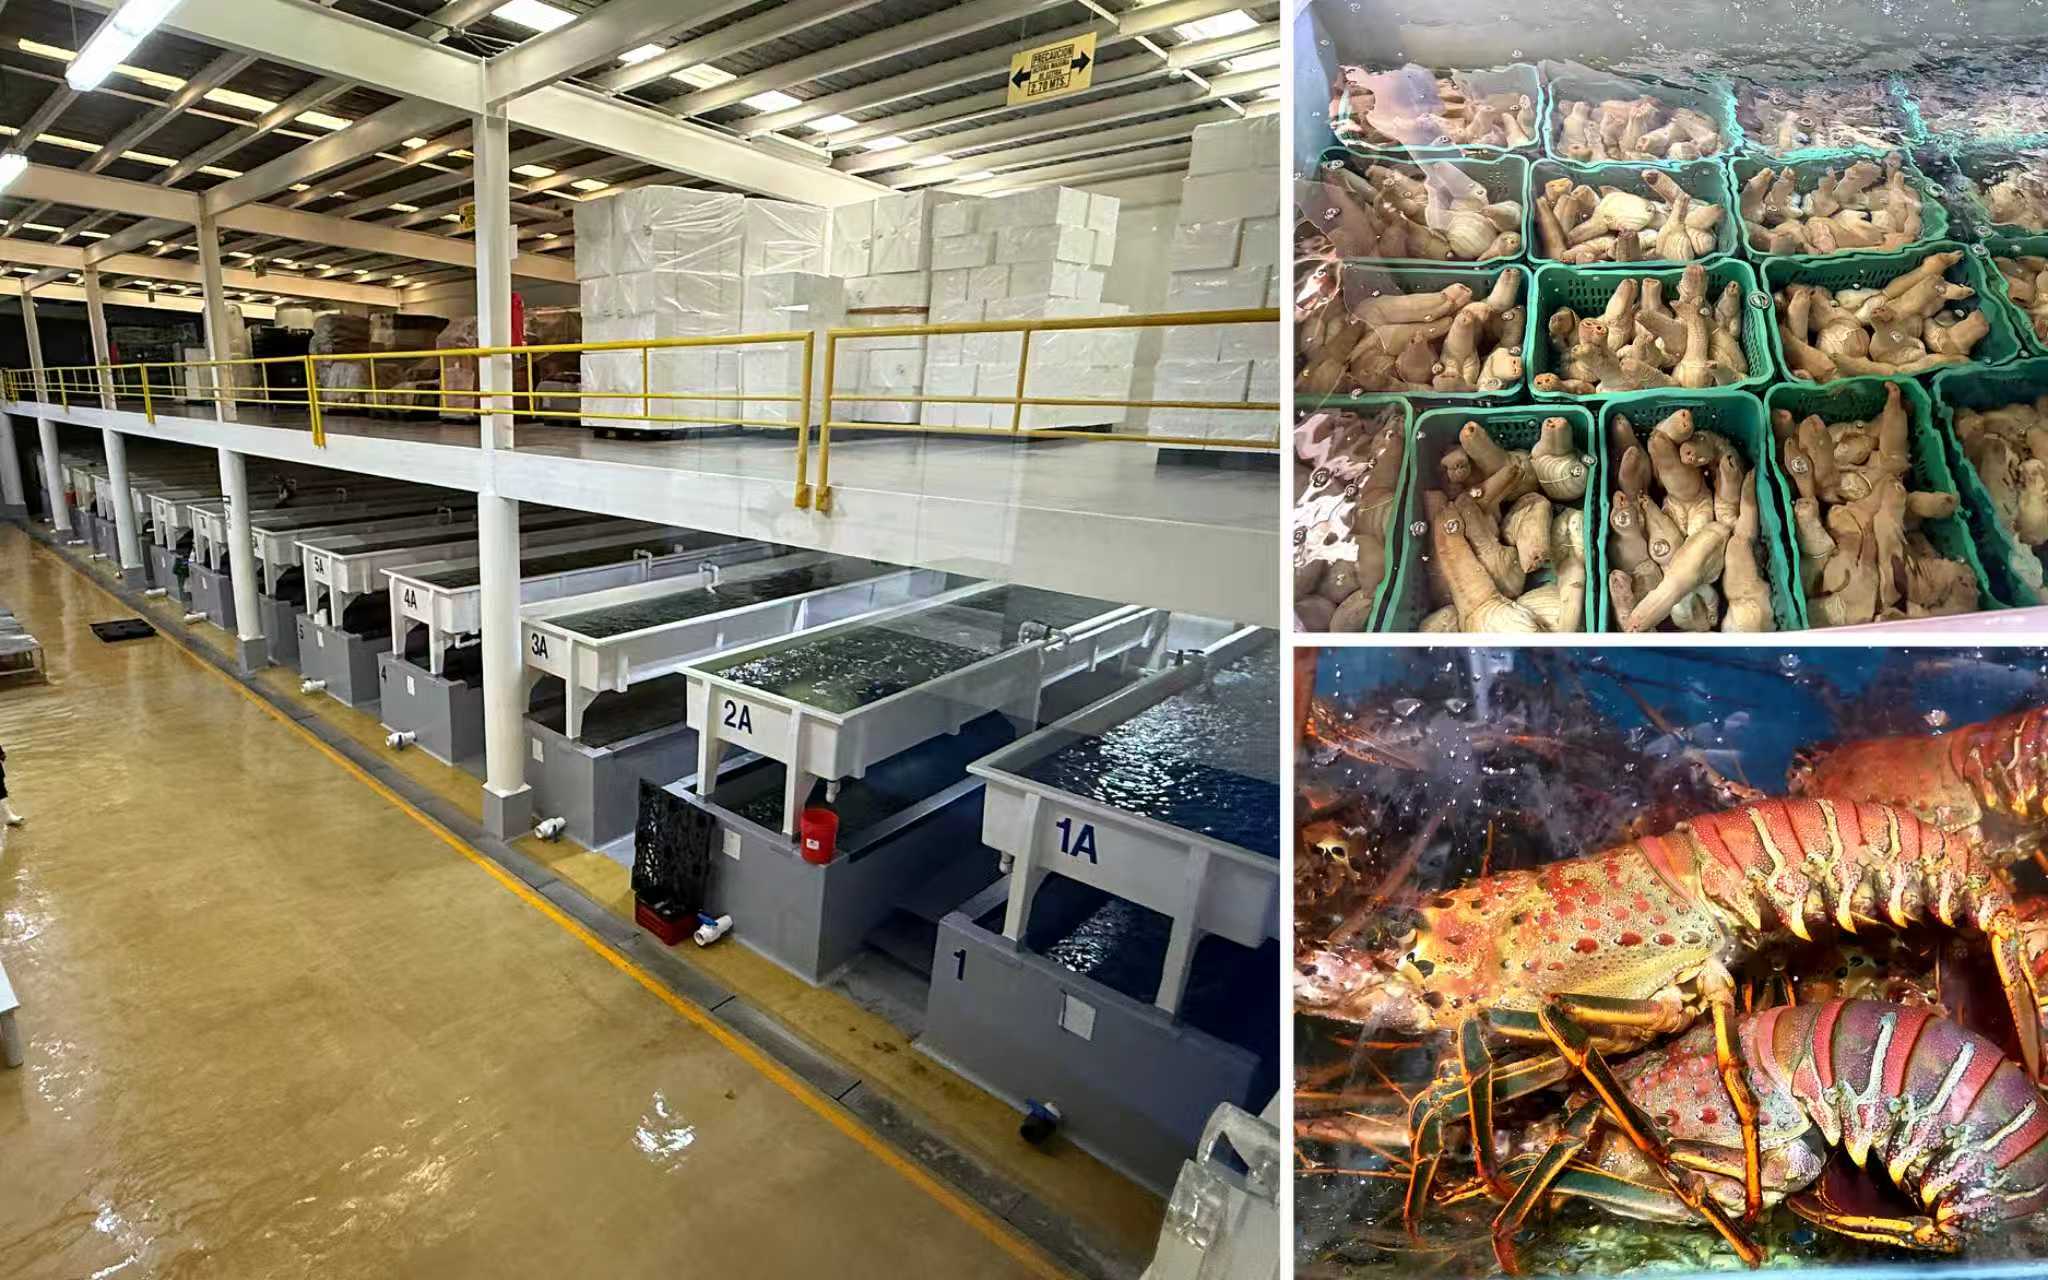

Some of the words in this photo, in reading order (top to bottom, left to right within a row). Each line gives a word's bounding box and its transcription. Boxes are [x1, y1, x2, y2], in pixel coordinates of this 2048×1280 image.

[314, 556, 324, 575] 5A
[404, 588, 417, 609] 4A
[298, 624, 304, 640] 5
[531, 632, 548, 659] 3A
[381, 665, 387, 682] 4
[724, 700, 752, 735] 2A
[1056, 817, 1098, 865] 1A
[953, 949, 967, 981] 1
